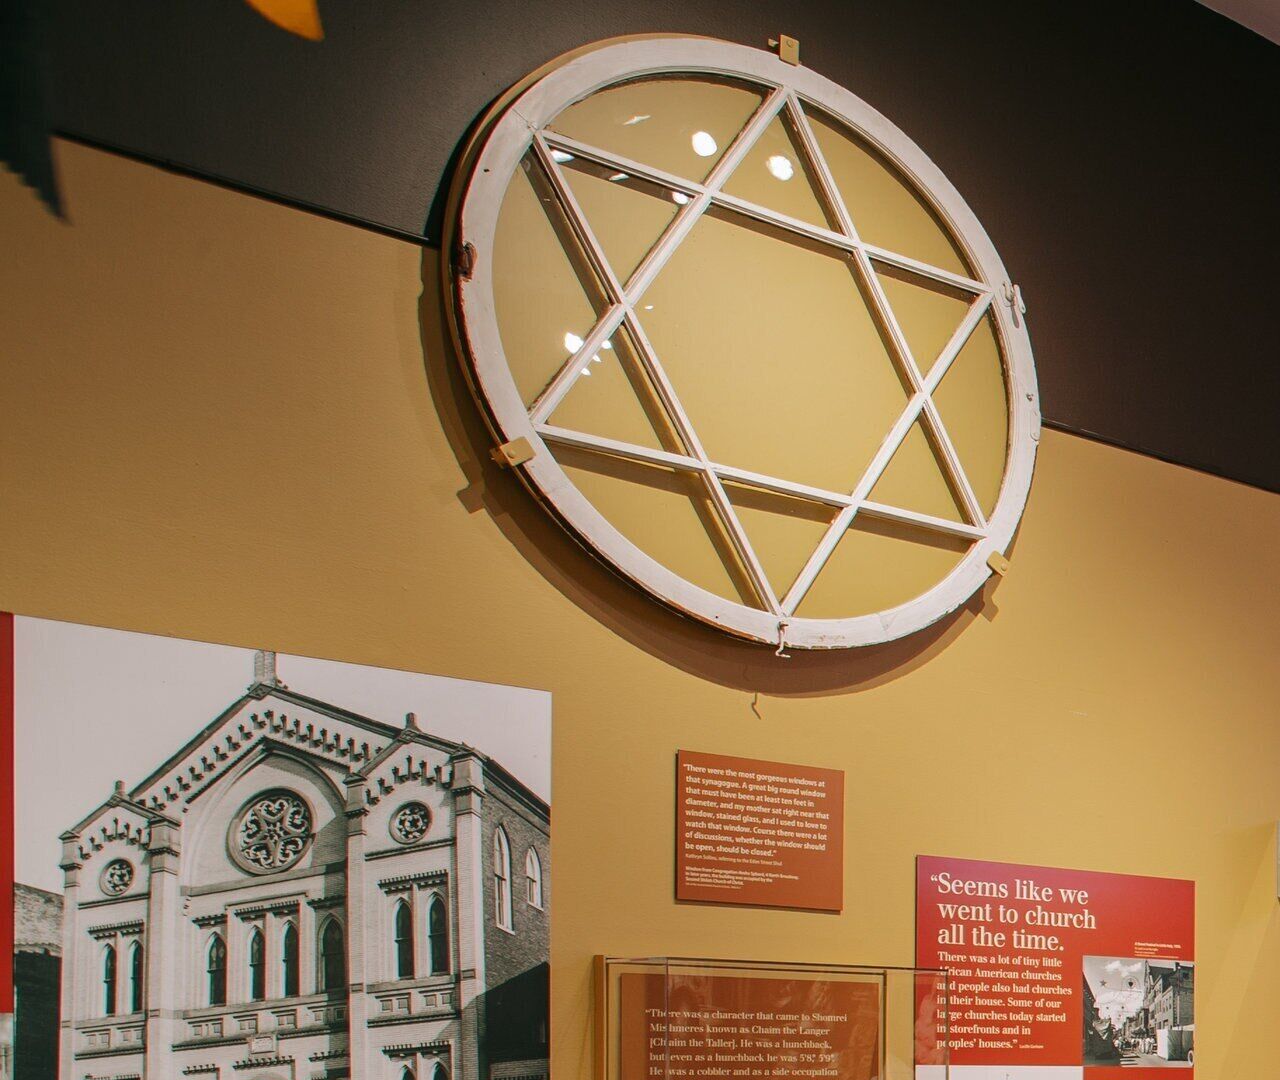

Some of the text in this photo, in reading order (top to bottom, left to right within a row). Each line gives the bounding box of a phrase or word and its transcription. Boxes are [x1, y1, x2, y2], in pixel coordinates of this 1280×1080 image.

[1014, 879, 1053, 902] like
[1058, 888, 1088, 905] we
[936, 903, 1096, 929] went to church
[937, 923, 1064, 951] all the time.
